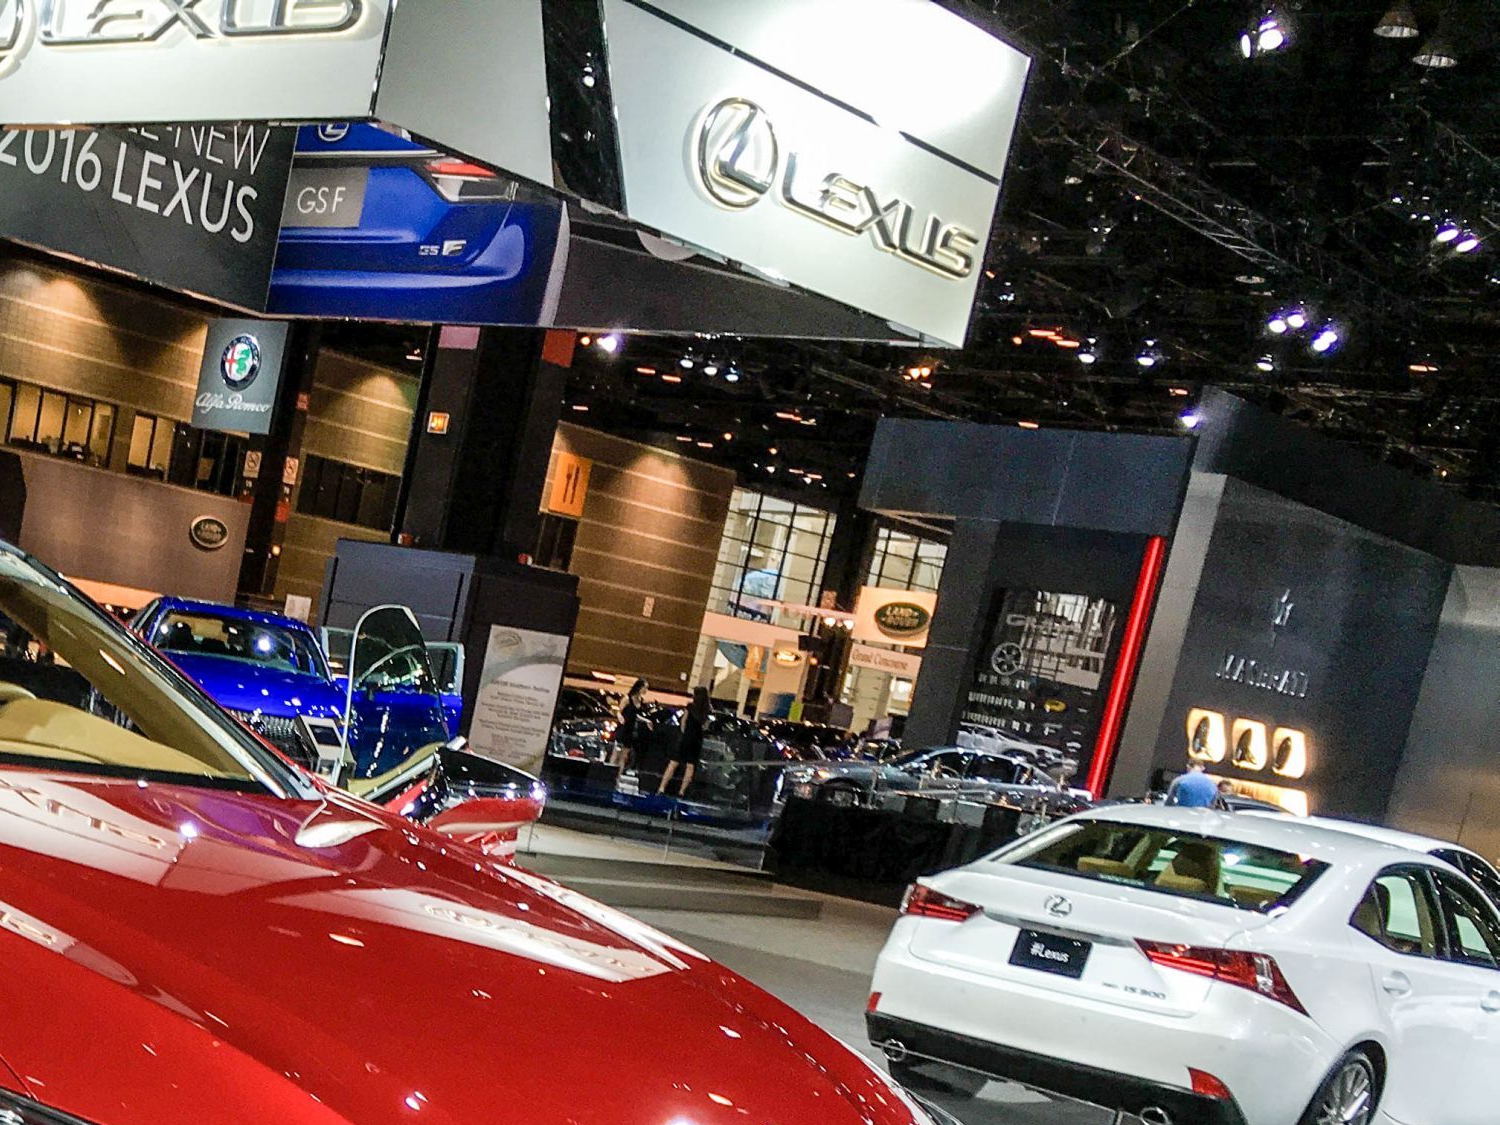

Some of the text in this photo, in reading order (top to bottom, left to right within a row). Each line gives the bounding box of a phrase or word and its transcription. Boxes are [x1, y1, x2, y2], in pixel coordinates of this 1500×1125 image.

[39, 0, 363, 47] LEXUS
[111, 141, 258, 243] LEXUS
[782, 151, 980, 280] LEXUS
[195, 392, 271, 414] Alfa Romeo
[1030, 941, 1070, 963] #Lexus
